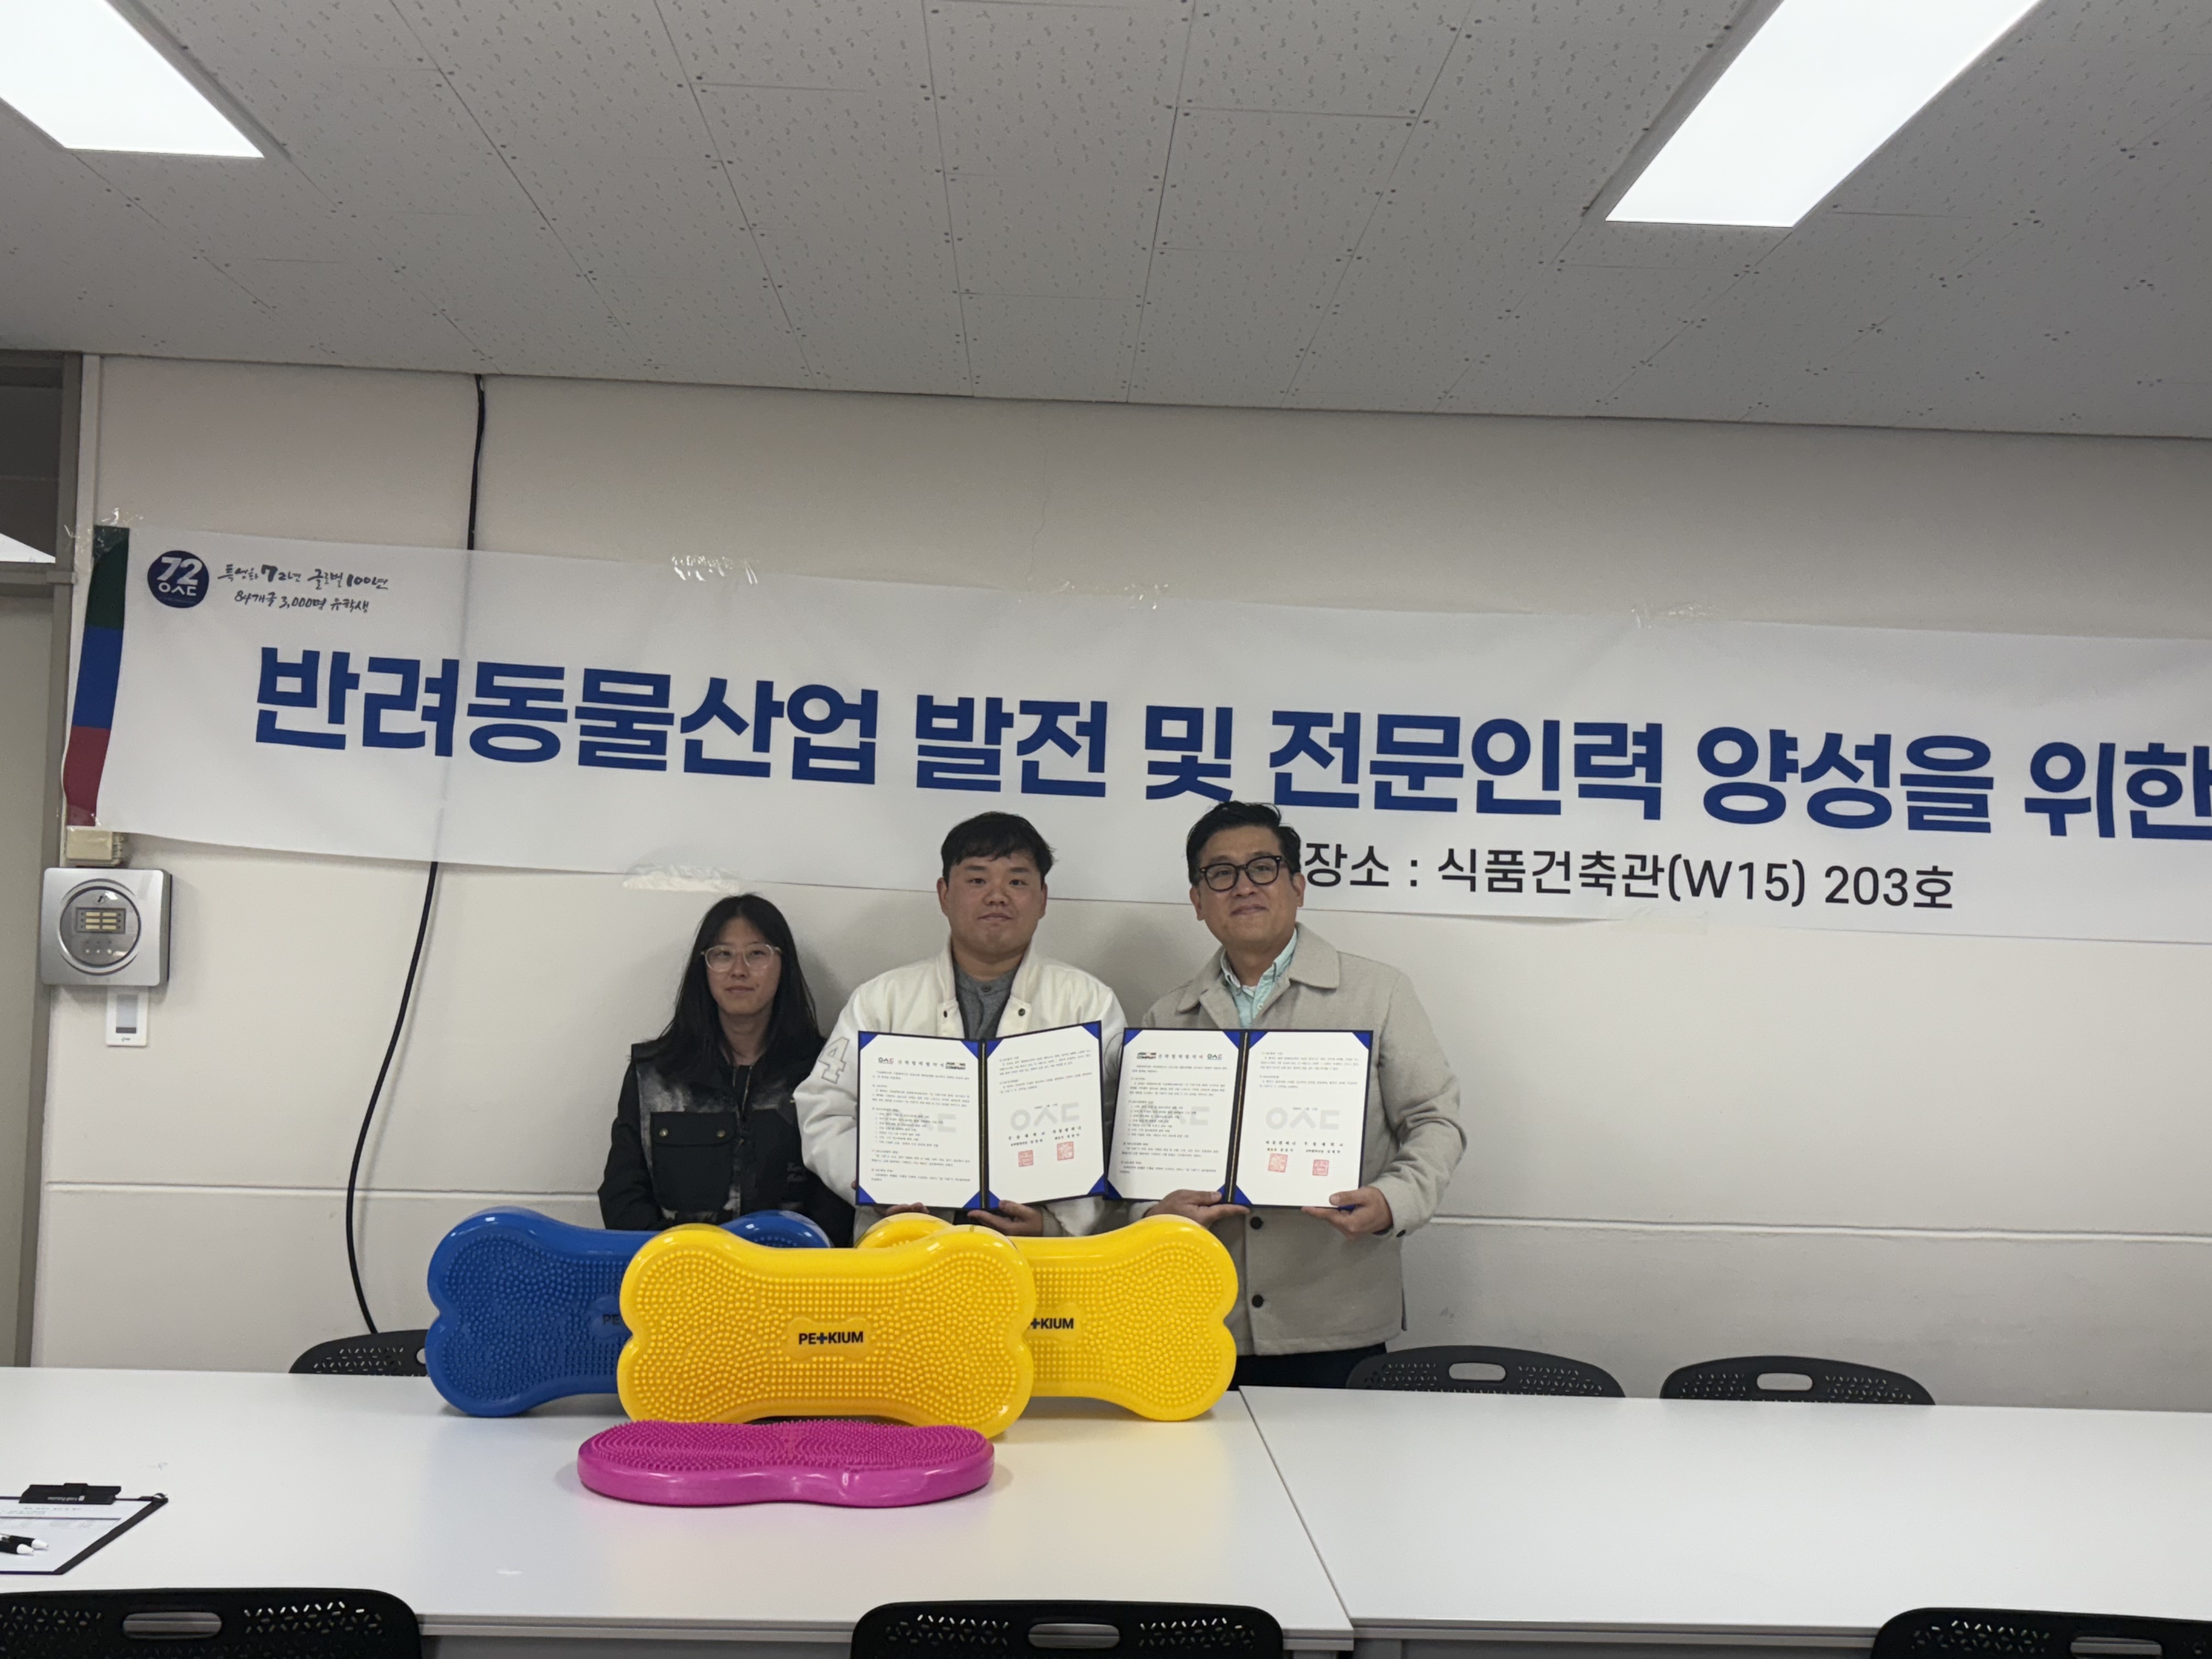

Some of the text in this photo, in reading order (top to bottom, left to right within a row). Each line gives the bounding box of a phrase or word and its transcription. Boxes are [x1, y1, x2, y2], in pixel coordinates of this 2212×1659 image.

[157, 556, 202, 585] 72
[217, 564, 388, 590] 특성화 72년 글로벌 100년
[279, 596, 327, 610] 3,000명
[330, 597, 369, 613] 유학생
[256, 647, 2212, 841] 반려동물산업 발전 및 전문인력 양성을 위한
[1305, 843, 1390, 887] 장소
[1438, 849, 1805, 908] 식품건축관(W15)
[1825, 865, 1954, 909] 203호
[817, 1036, 850, 1085] 4
